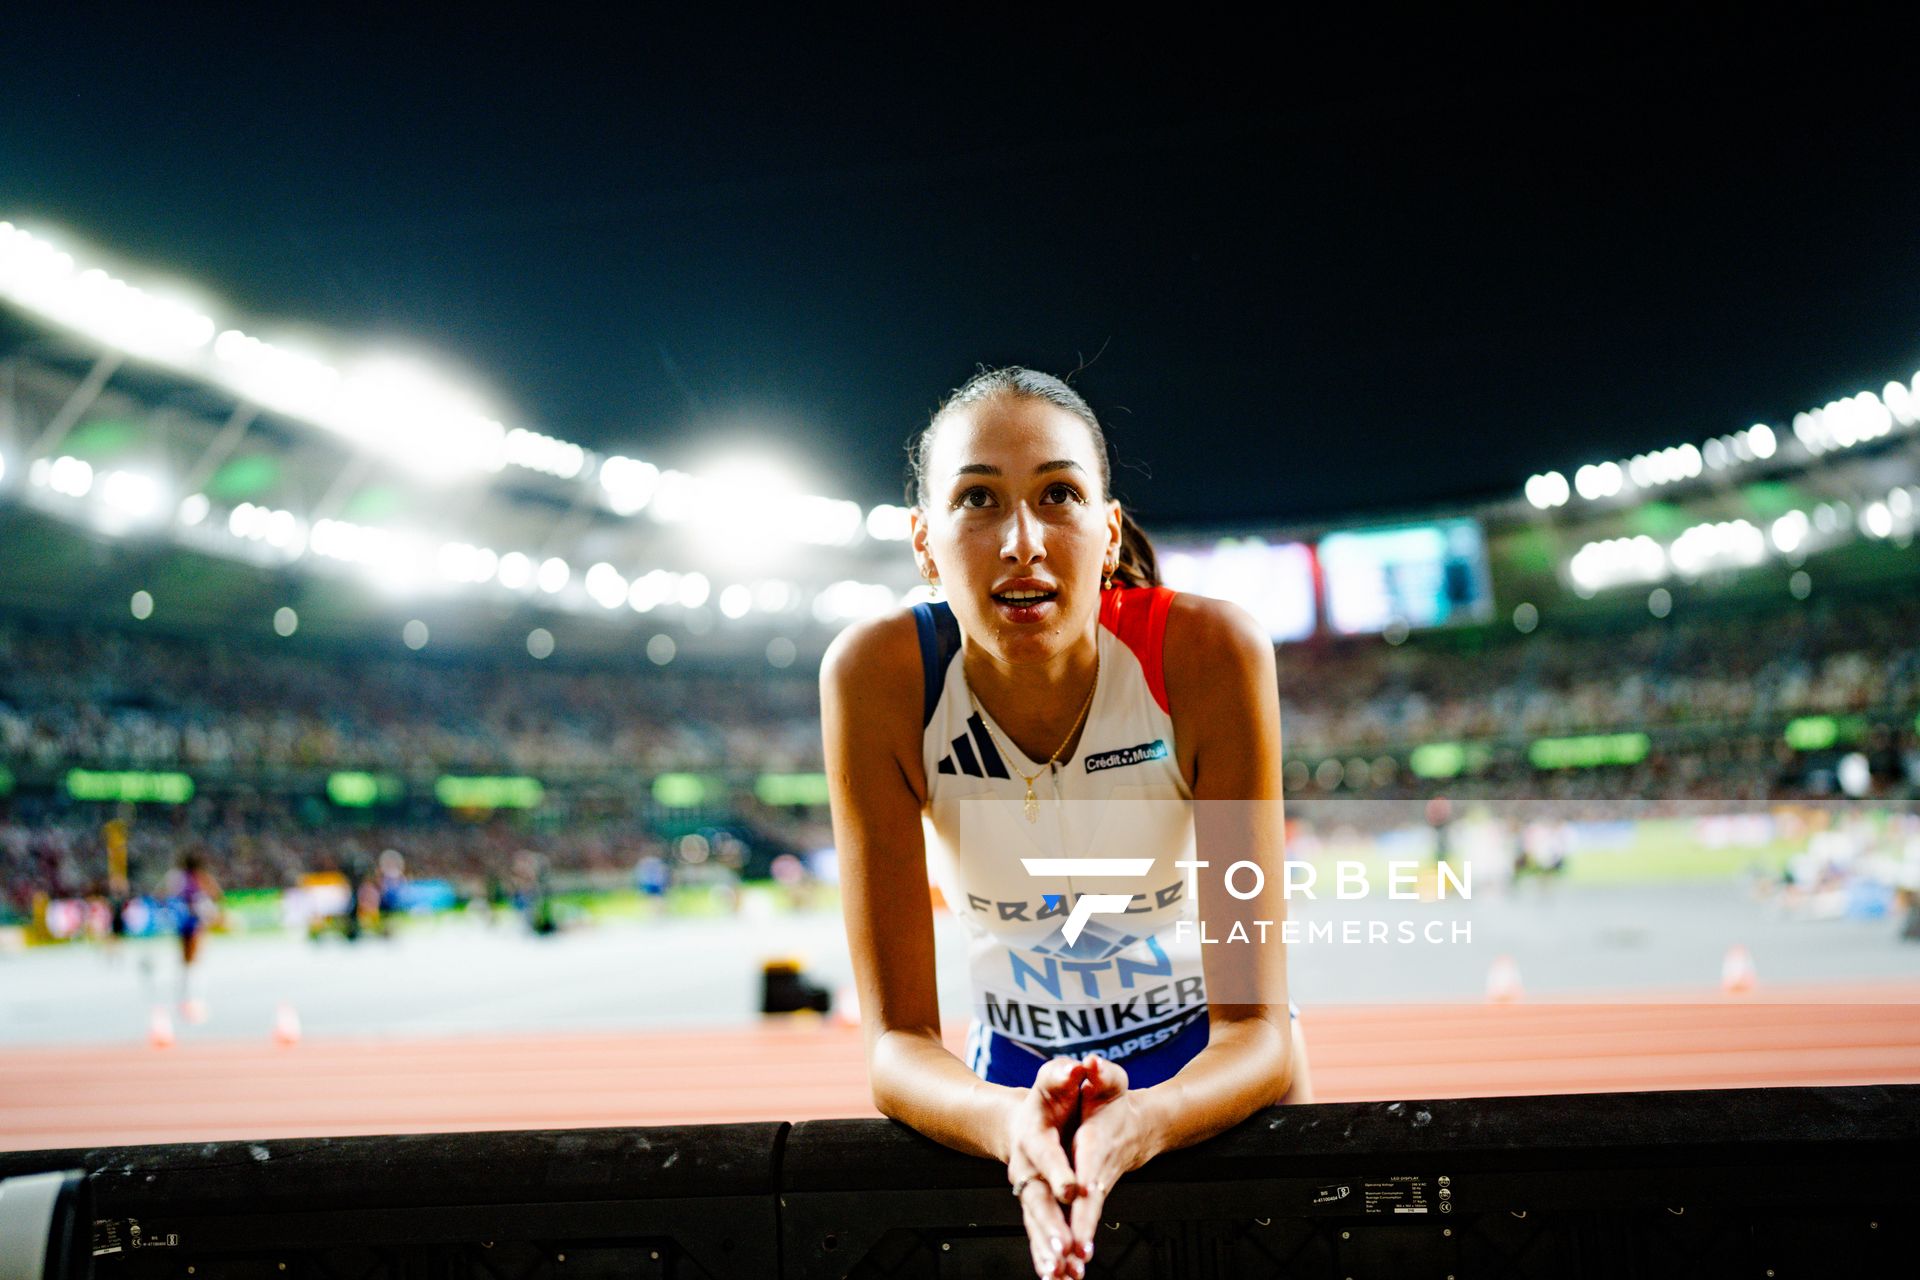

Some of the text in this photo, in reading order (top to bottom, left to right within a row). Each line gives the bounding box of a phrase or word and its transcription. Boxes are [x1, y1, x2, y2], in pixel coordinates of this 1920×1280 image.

[1086, 754, 1121, 770] Crédit
[966, 880, 1184, 922] FRACE
[1008, 934, 1173, 1001] NTN
[985, 976, 1206, 1041] MENIKER
